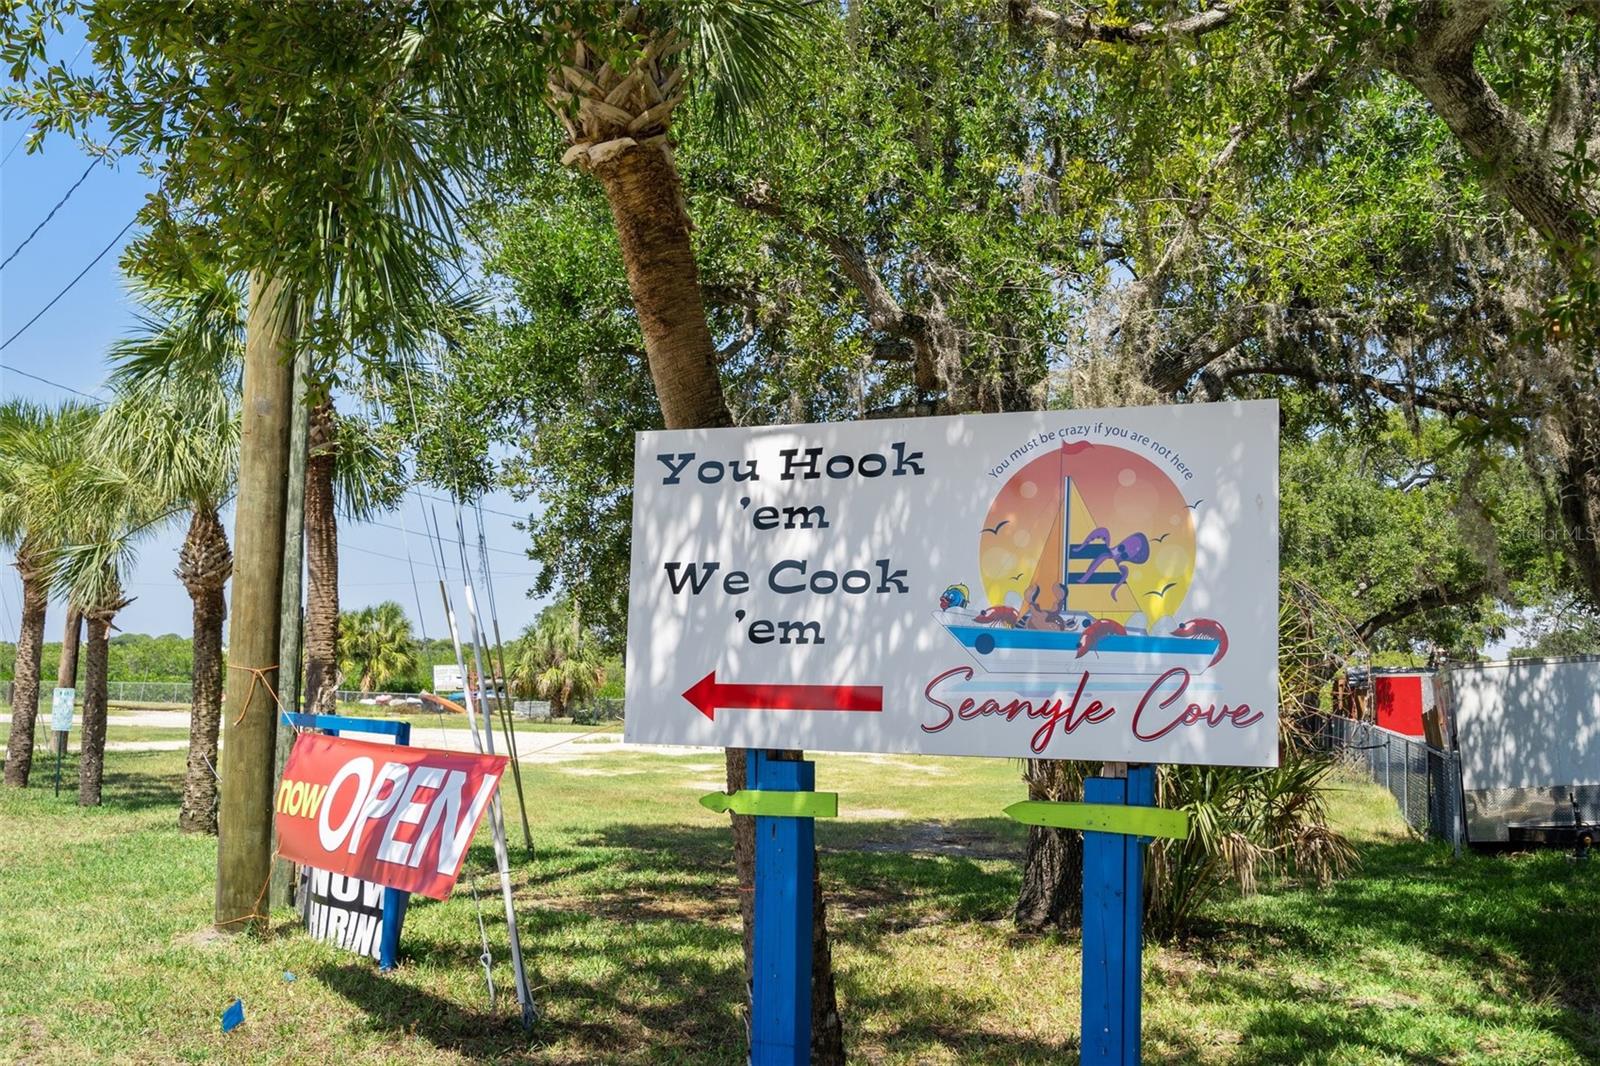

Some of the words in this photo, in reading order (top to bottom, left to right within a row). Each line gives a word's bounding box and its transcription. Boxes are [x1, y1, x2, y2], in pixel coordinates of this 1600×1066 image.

[657, 452, 760, 485] You
[779, 442, 925, 480] Hook
[988, 460, 1011, 479] You
[1009, 439, 1039, 462] must
[1039, 430, 1056, 444] be
[1058, 424, 1091, 438] crazy
[1094, 422, 1104, 433] if
[1105, 424, 1128, 439] you
[1130, 430, 1150, 446] are
[1150, 440, 1172, 460] not
[1170, 454, 1194, 480] here
[740, 496, 829, 530] 'em
[664, 561, 750, 595] We
[768, 559, 909, 595] Cook
[735, 609, 825, 644] 'em
[920, 666, 1116, 754] Seanyle
[1132, 667, 1264, 742] Cove
[276, 778, 329, 820] now
[318, 756, 498, 876] OPEN
